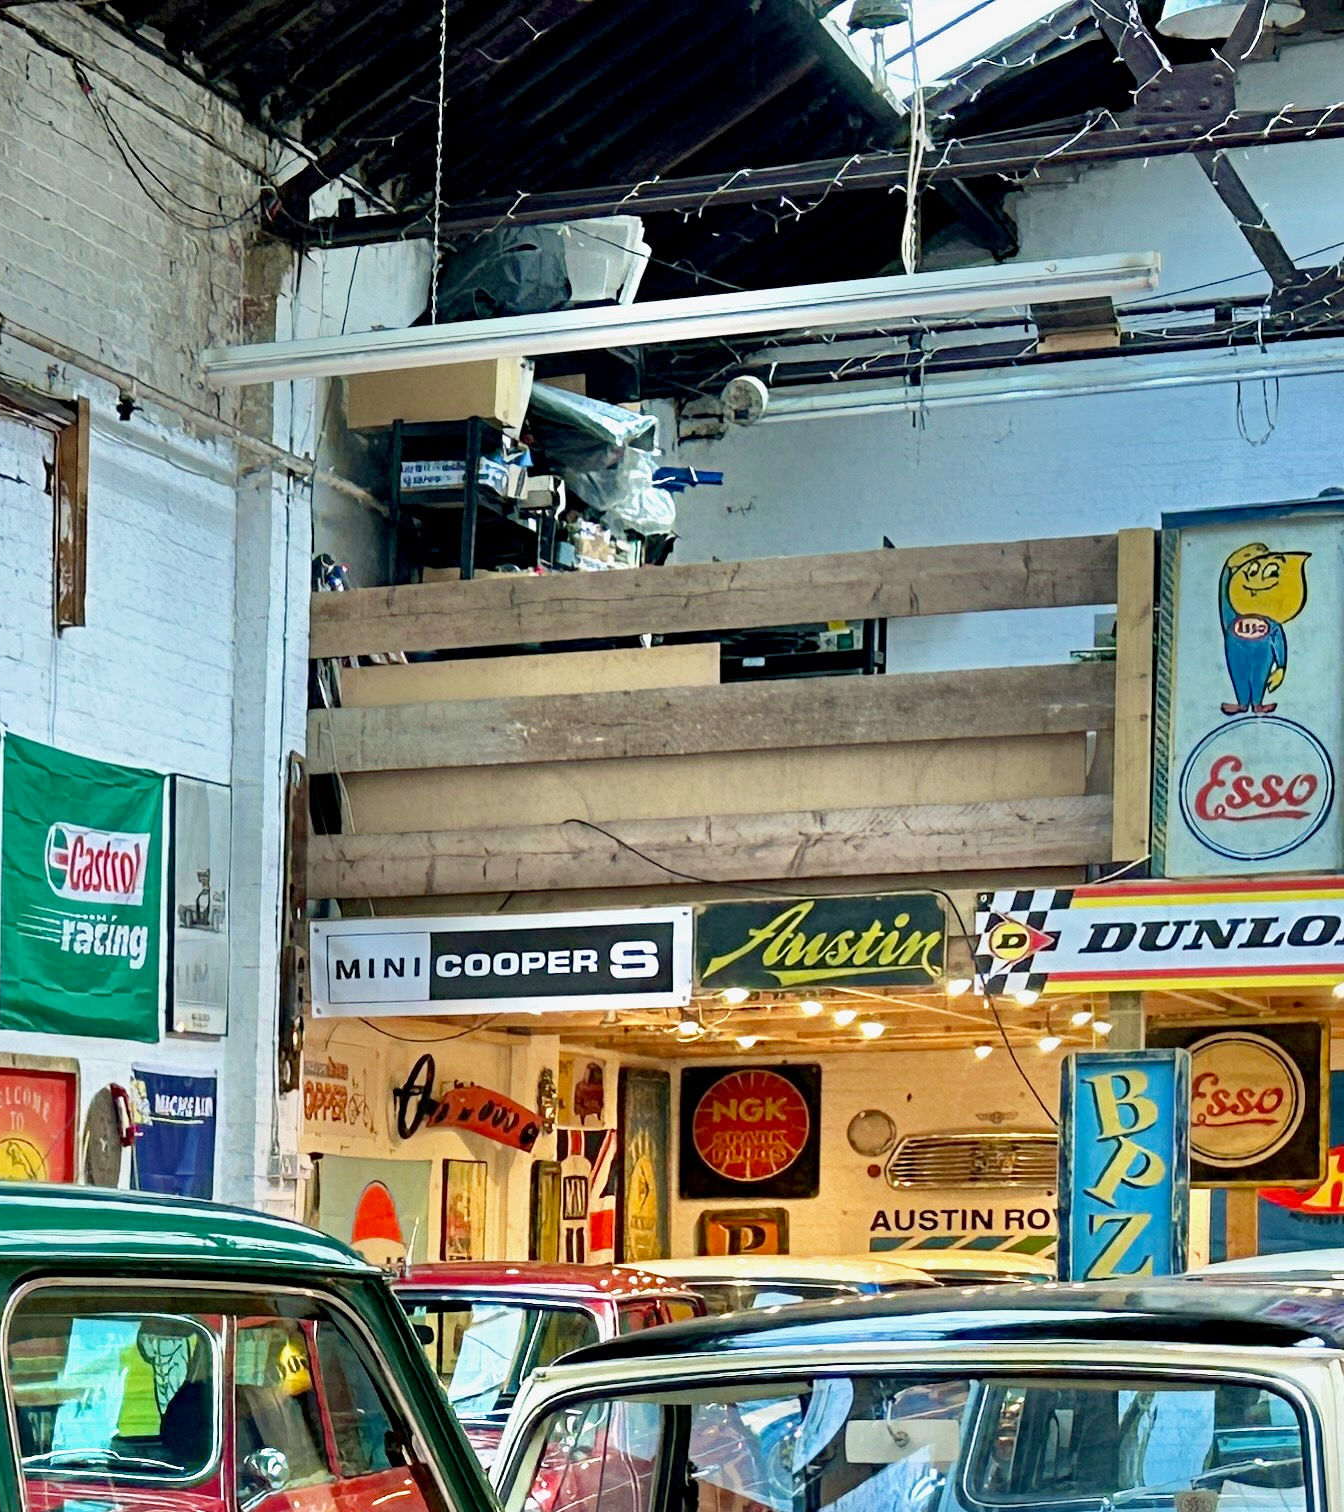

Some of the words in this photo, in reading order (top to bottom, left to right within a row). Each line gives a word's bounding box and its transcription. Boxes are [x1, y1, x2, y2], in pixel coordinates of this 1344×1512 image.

[1195, 755, 1318, 821] Esso
[69, 835, 141, 894] Castrol
[61, 918, 148, 971] racing
[702, 900, 942, 980] Austin
[1078, 915, 1344, 953] DUNLO
[335, 956, 421, 981] MINI
[435, 949, 599, 977] COOPER
[609, 940, 660, 979] S
[10, 1111, 25, 1131] TO
[712, 1097, 787, 1122] NGK
[1081, 1070, 1166, 1280] BPZ
[870, 1209, 993, 1231] AUSTIN
[1005, 1208, 1058, 1230] RO
